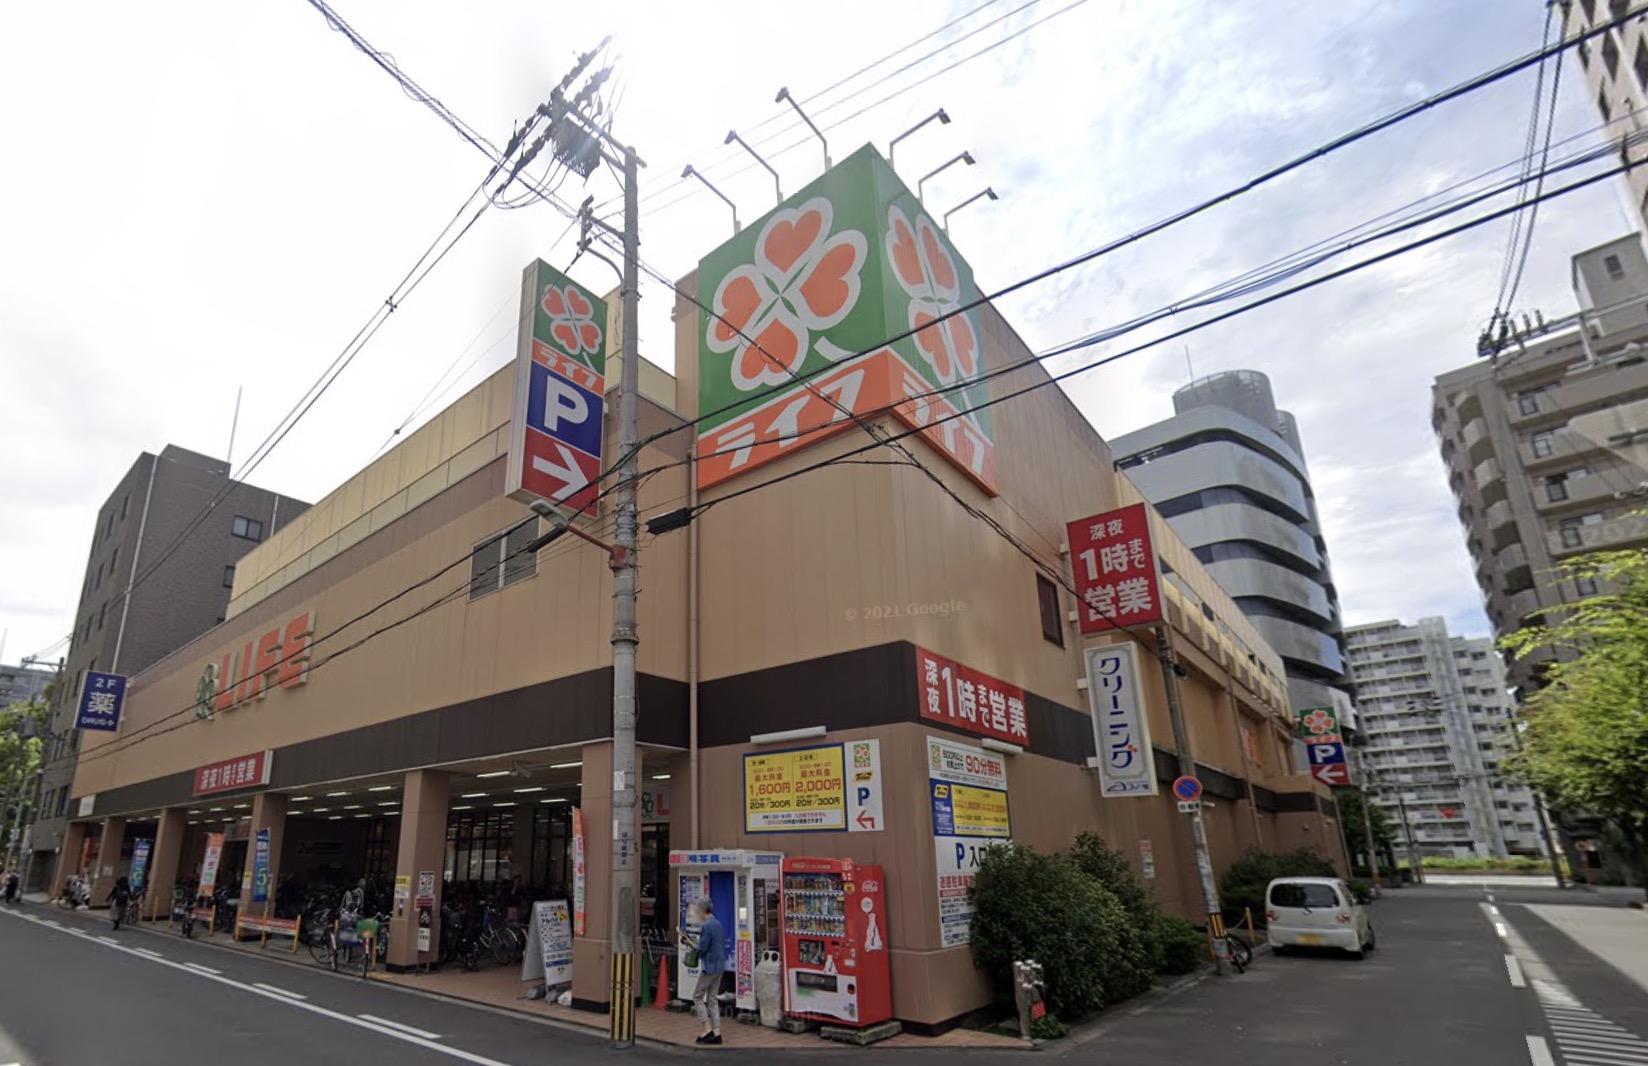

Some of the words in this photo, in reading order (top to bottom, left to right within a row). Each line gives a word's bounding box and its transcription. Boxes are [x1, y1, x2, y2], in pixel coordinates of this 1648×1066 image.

[540, 346, 597, 389] ライフ
[544, 375, 588, 432] P
[715, 368, 865, 470] ライフ
[903, 372, 985, 476] ライフ
[1090, 519, 1124, 541] 深夜
[1084, 577, 1152, 622] 営業
[216, 611, 314, 712] LIFE
[95, 677, 117, 689] 2F
[87, 691, 117, 715] 薬
[1099, 656, 1138, 769] クリーニング
[965, 755, 1002, 778] 90分無料
[1314, 745, 1336, 764] P
[749, 782, 790, 796] 1,600円
[795, 778, 841, 793] 2,000円
[857, 786, 870, 806] P
[956, 842, 965, 869] P
